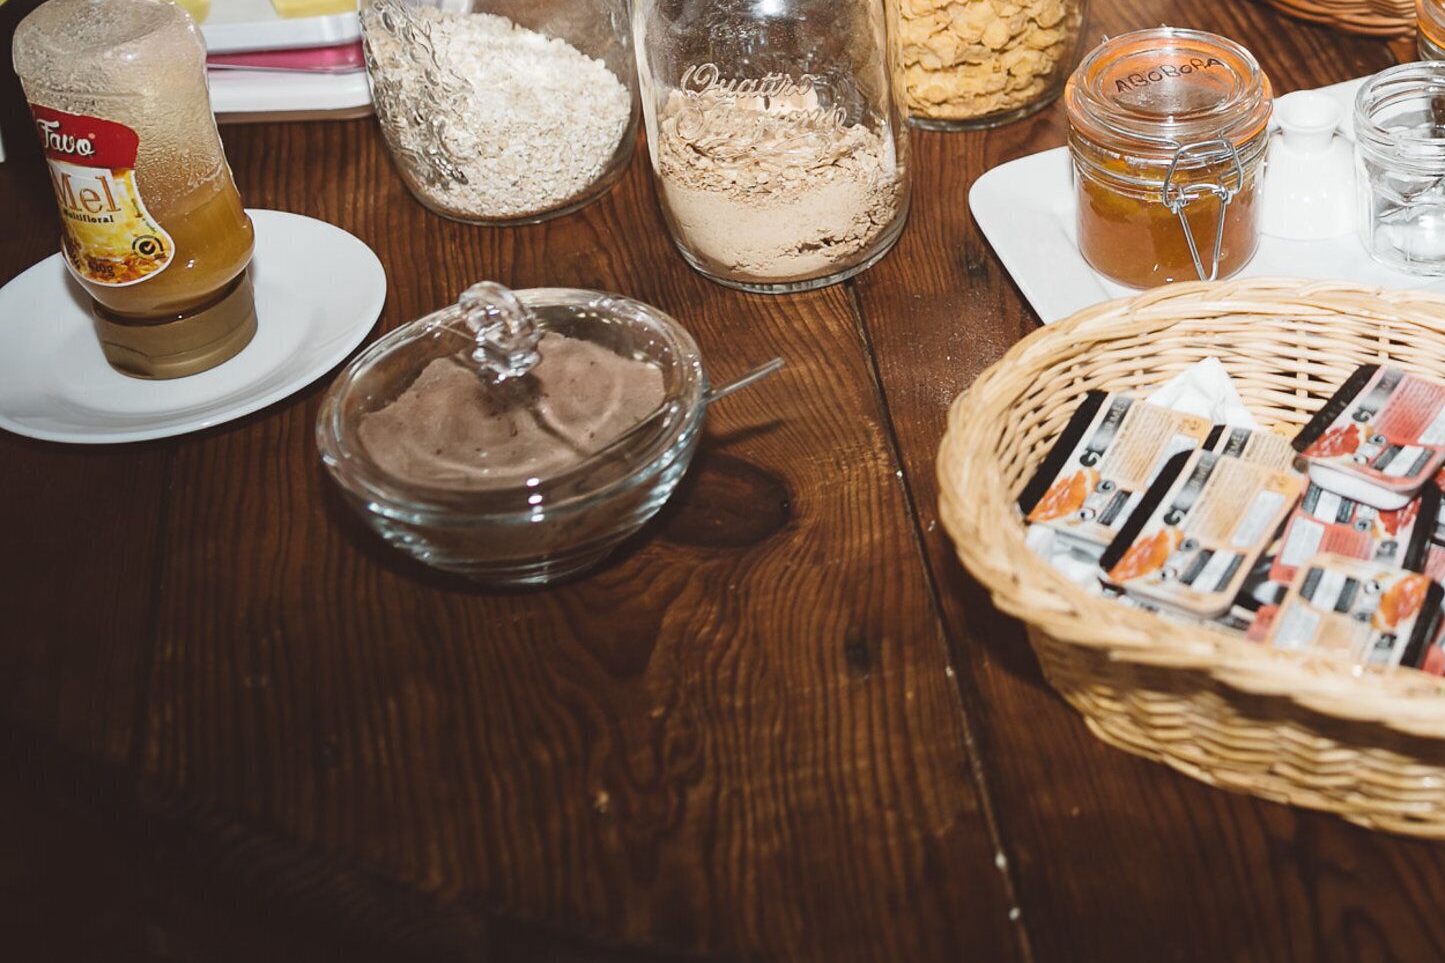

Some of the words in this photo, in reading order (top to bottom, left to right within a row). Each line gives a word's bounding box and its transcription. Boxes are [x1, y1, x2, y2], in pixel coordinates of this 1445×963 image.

[681, 63, 816, 98] Quattro
[1114, 57, 1226, 93] ABOBORA
[36, 118, 95, 157] Favo
[49, 165, 122, 214] Mel
